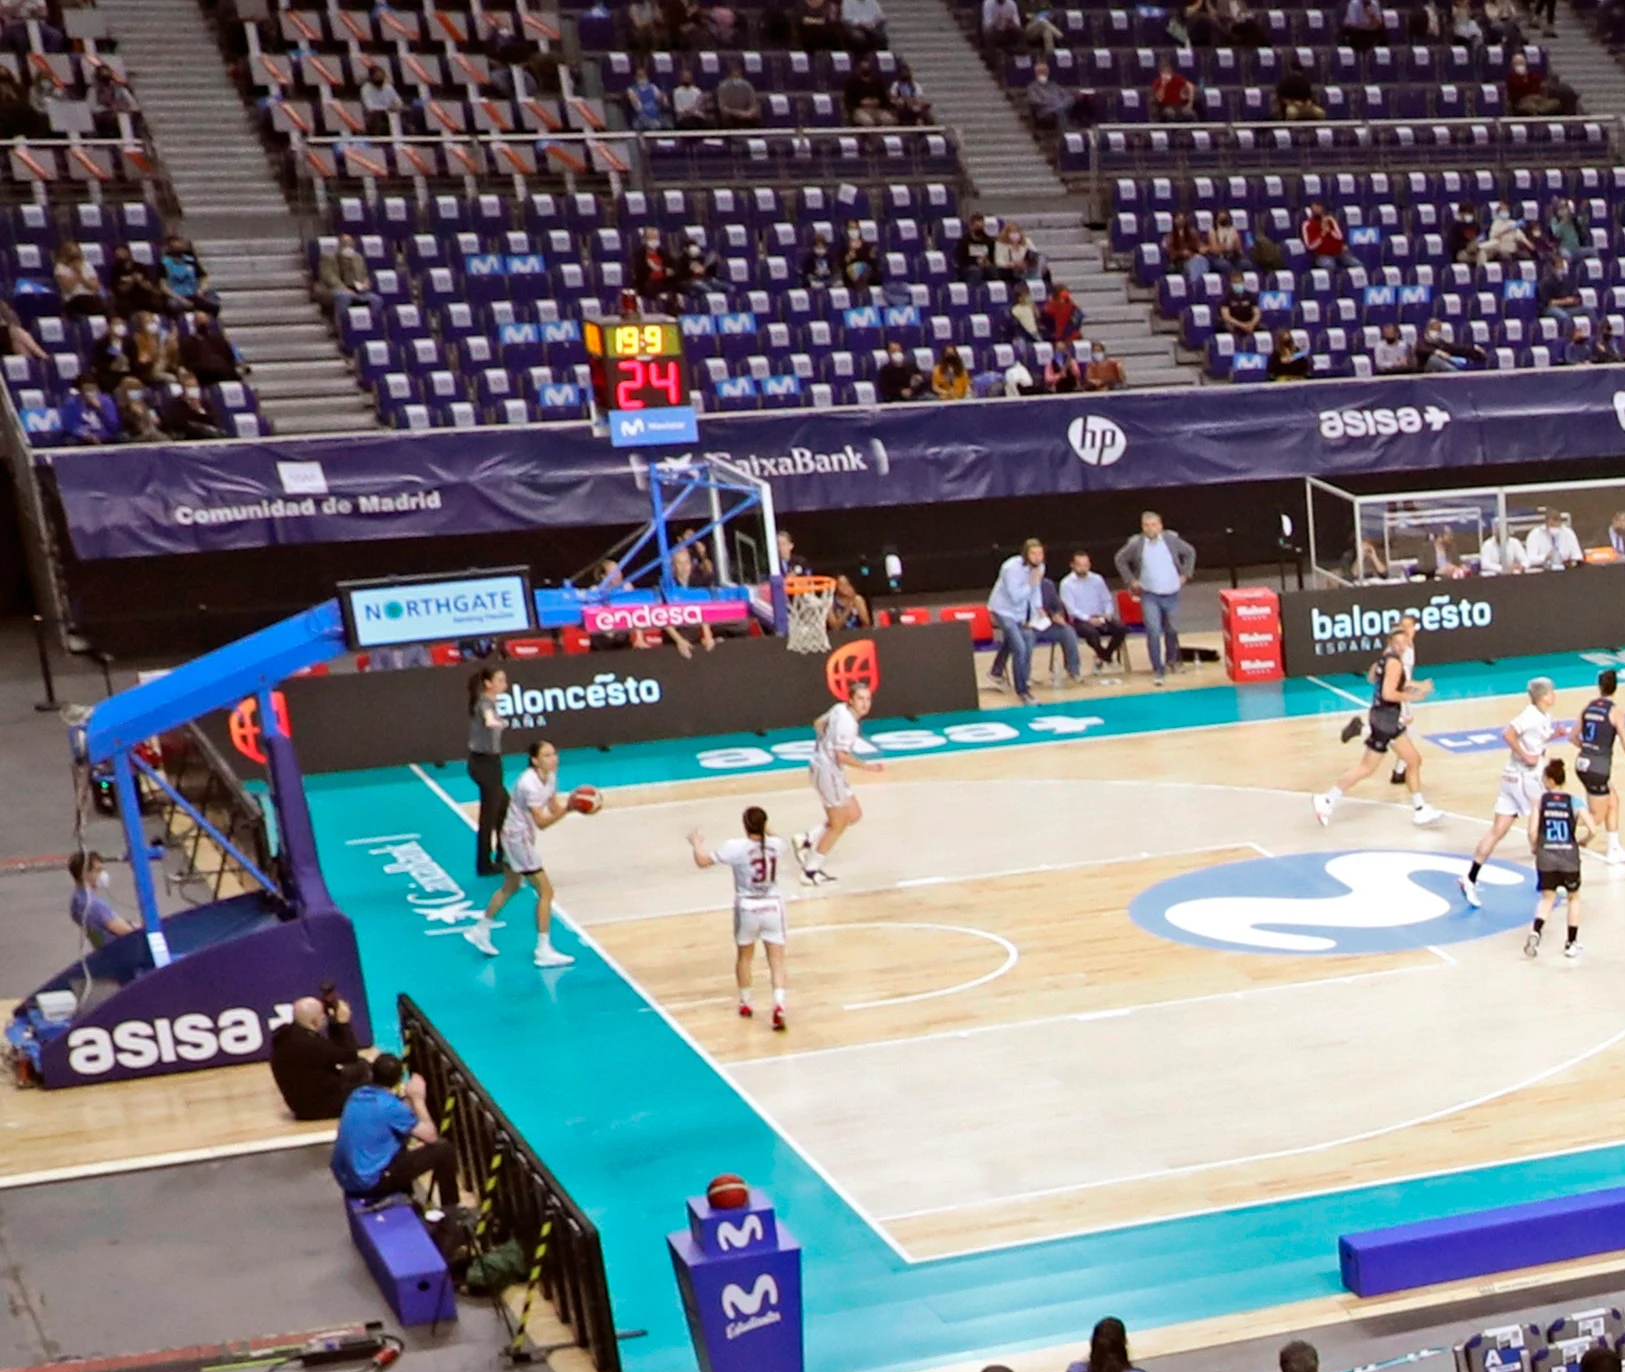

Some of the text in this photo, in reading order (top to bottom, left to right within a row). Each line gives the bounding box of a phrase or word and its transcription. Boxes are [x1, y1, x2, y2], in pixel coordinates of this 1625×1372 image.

[616, 361, 680, 410] 24
[175, 489, 442, 525] Comunidad de Madrid
[365, 589, 514, 622] NORTHGATE
[595, 605, 703, 631] endesa
[1316, 637, 1382, 656] ESPAÑA
[494, 673, 661, 716] aloncesto
[1546, 819, 1569, 841] 20
[749, 858, 778, 884] 31
[1484, 1349, 1503, 1368] A
